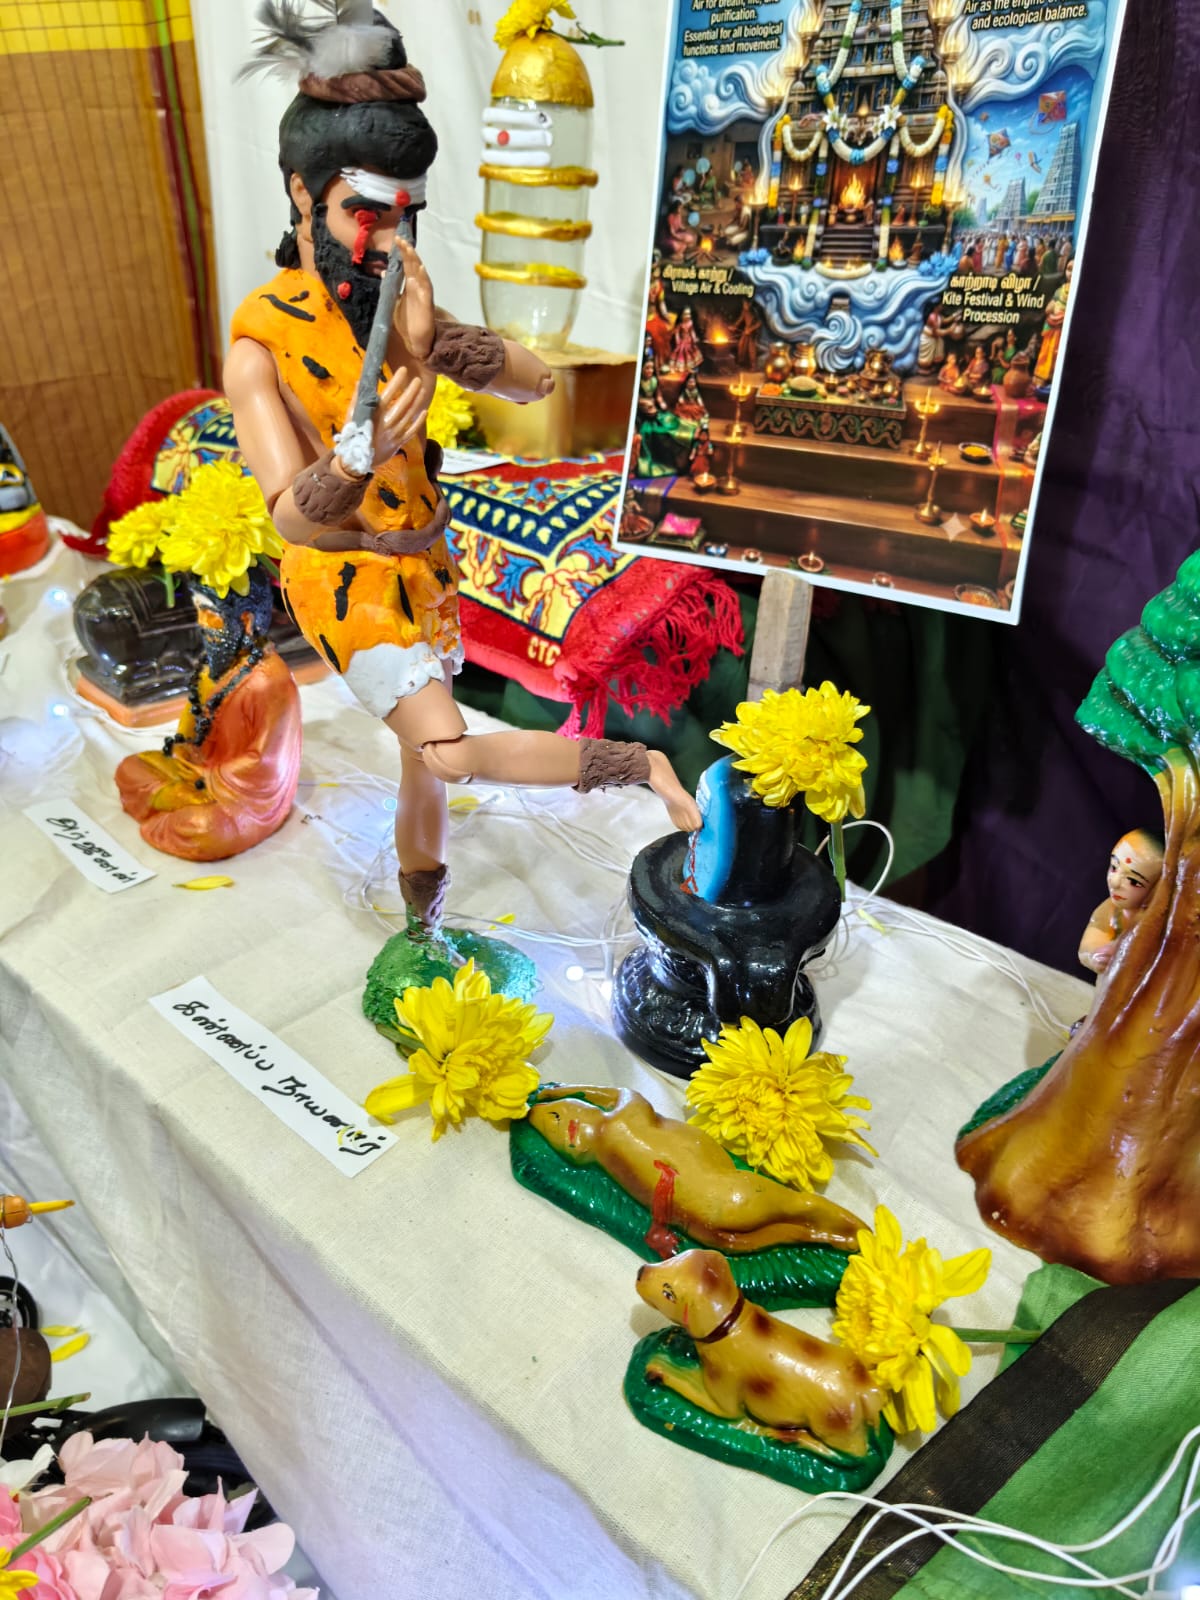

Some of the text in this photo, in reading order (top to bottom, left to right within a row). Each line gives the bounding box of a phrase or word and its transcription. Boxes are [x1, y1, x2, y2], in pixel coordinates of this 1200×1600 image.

[964, 1, 978, 14] Air
[979, 2, 992, 11] as
[994, 0, 1009, 9] the
[710, 8, 757, 25] purification.
[971, 4, 1088, 29] and ecological balance.
[684, 22, 784, 42] Essential for all biological
[683, 38, 781, 56] functions and movement.
[672, 280, 699, 296] Village
[699, 281, 713, 294] Air
[722, 282, 755, 298] Cooling
[1000, 272, 1032, 293] விழா
[942, 291, 1046, 308] Kite Festival & Wind
[963, 307, 1020, 324] Procession
[527, 635, 561, 667] CTC
